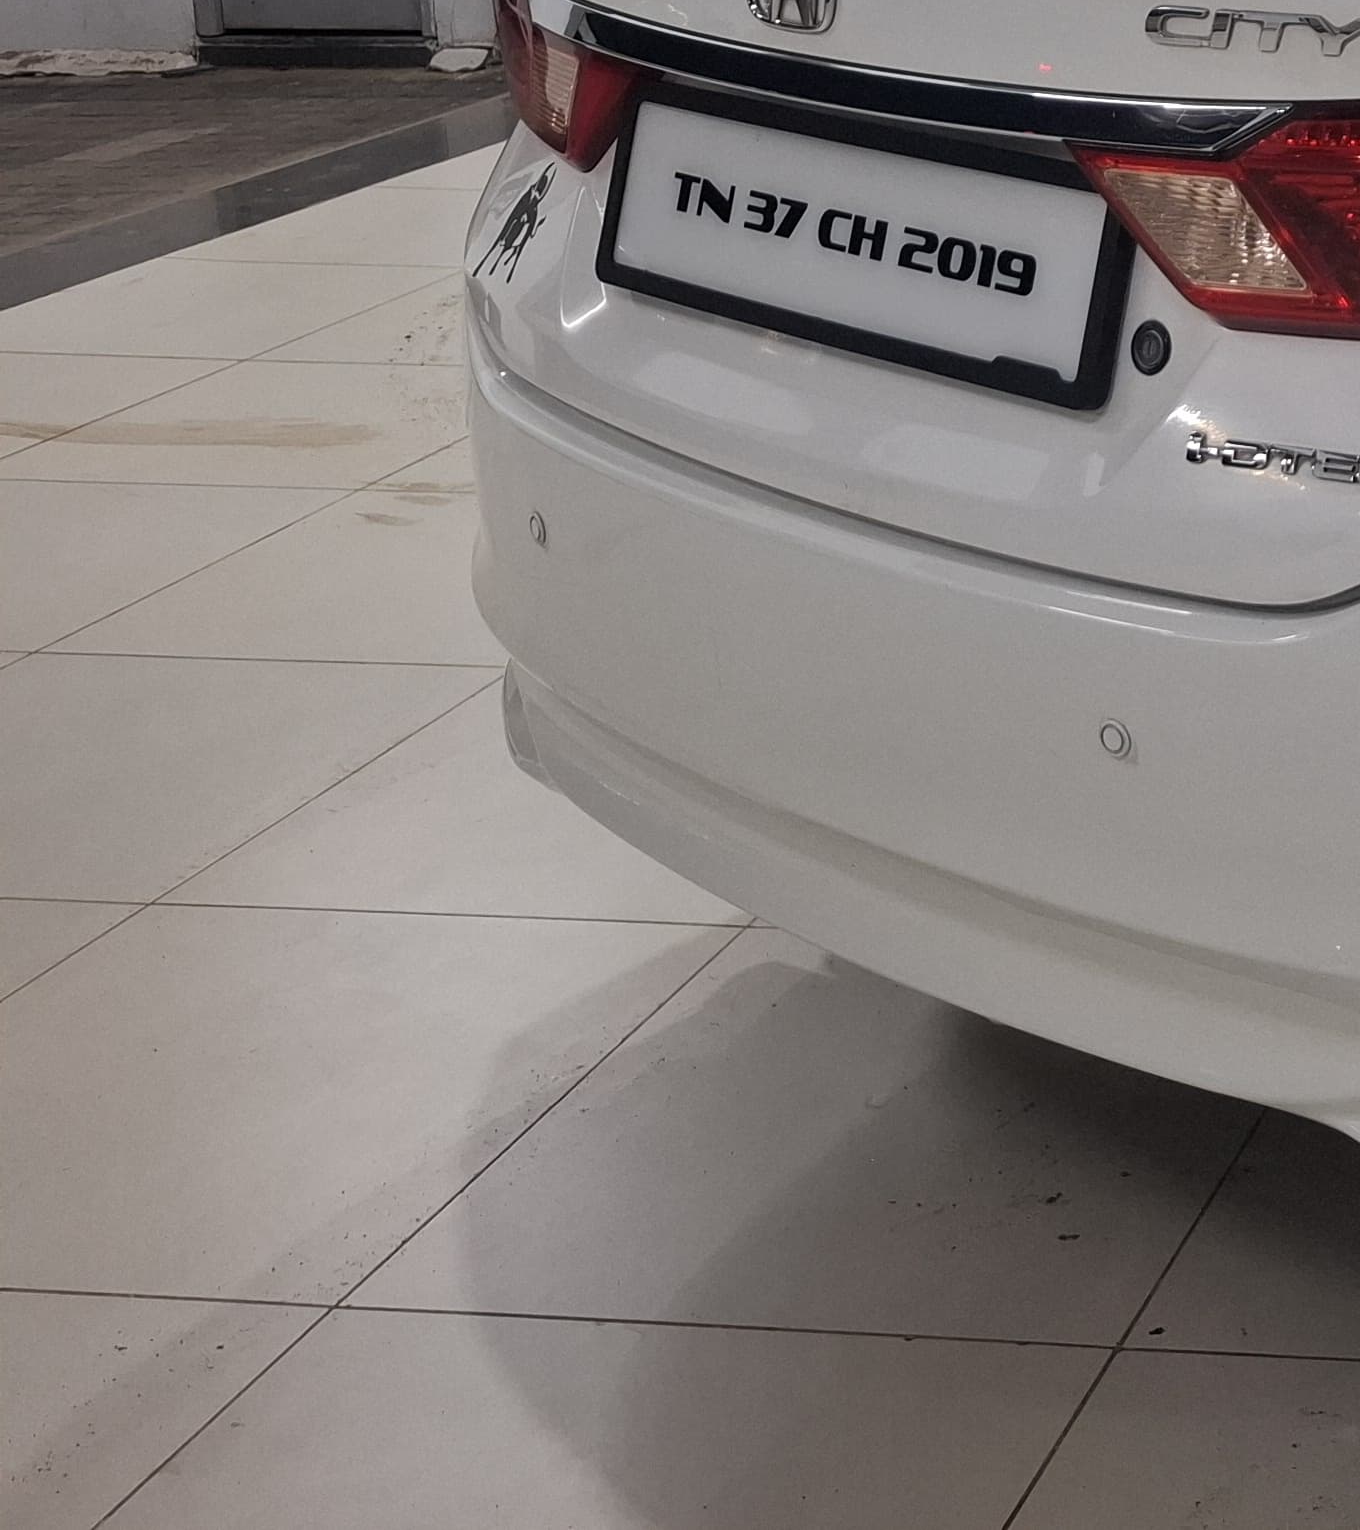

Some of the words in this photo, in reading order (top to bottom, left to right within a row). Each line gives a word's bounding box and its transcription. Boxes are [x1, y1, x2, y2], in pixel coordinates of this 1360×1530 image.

[674, 172, 737, 226] TN
[743, 188, 809, 239] 37
[817, 208, 889, 263] CH
[897, 226, 1038, 297] 2019
